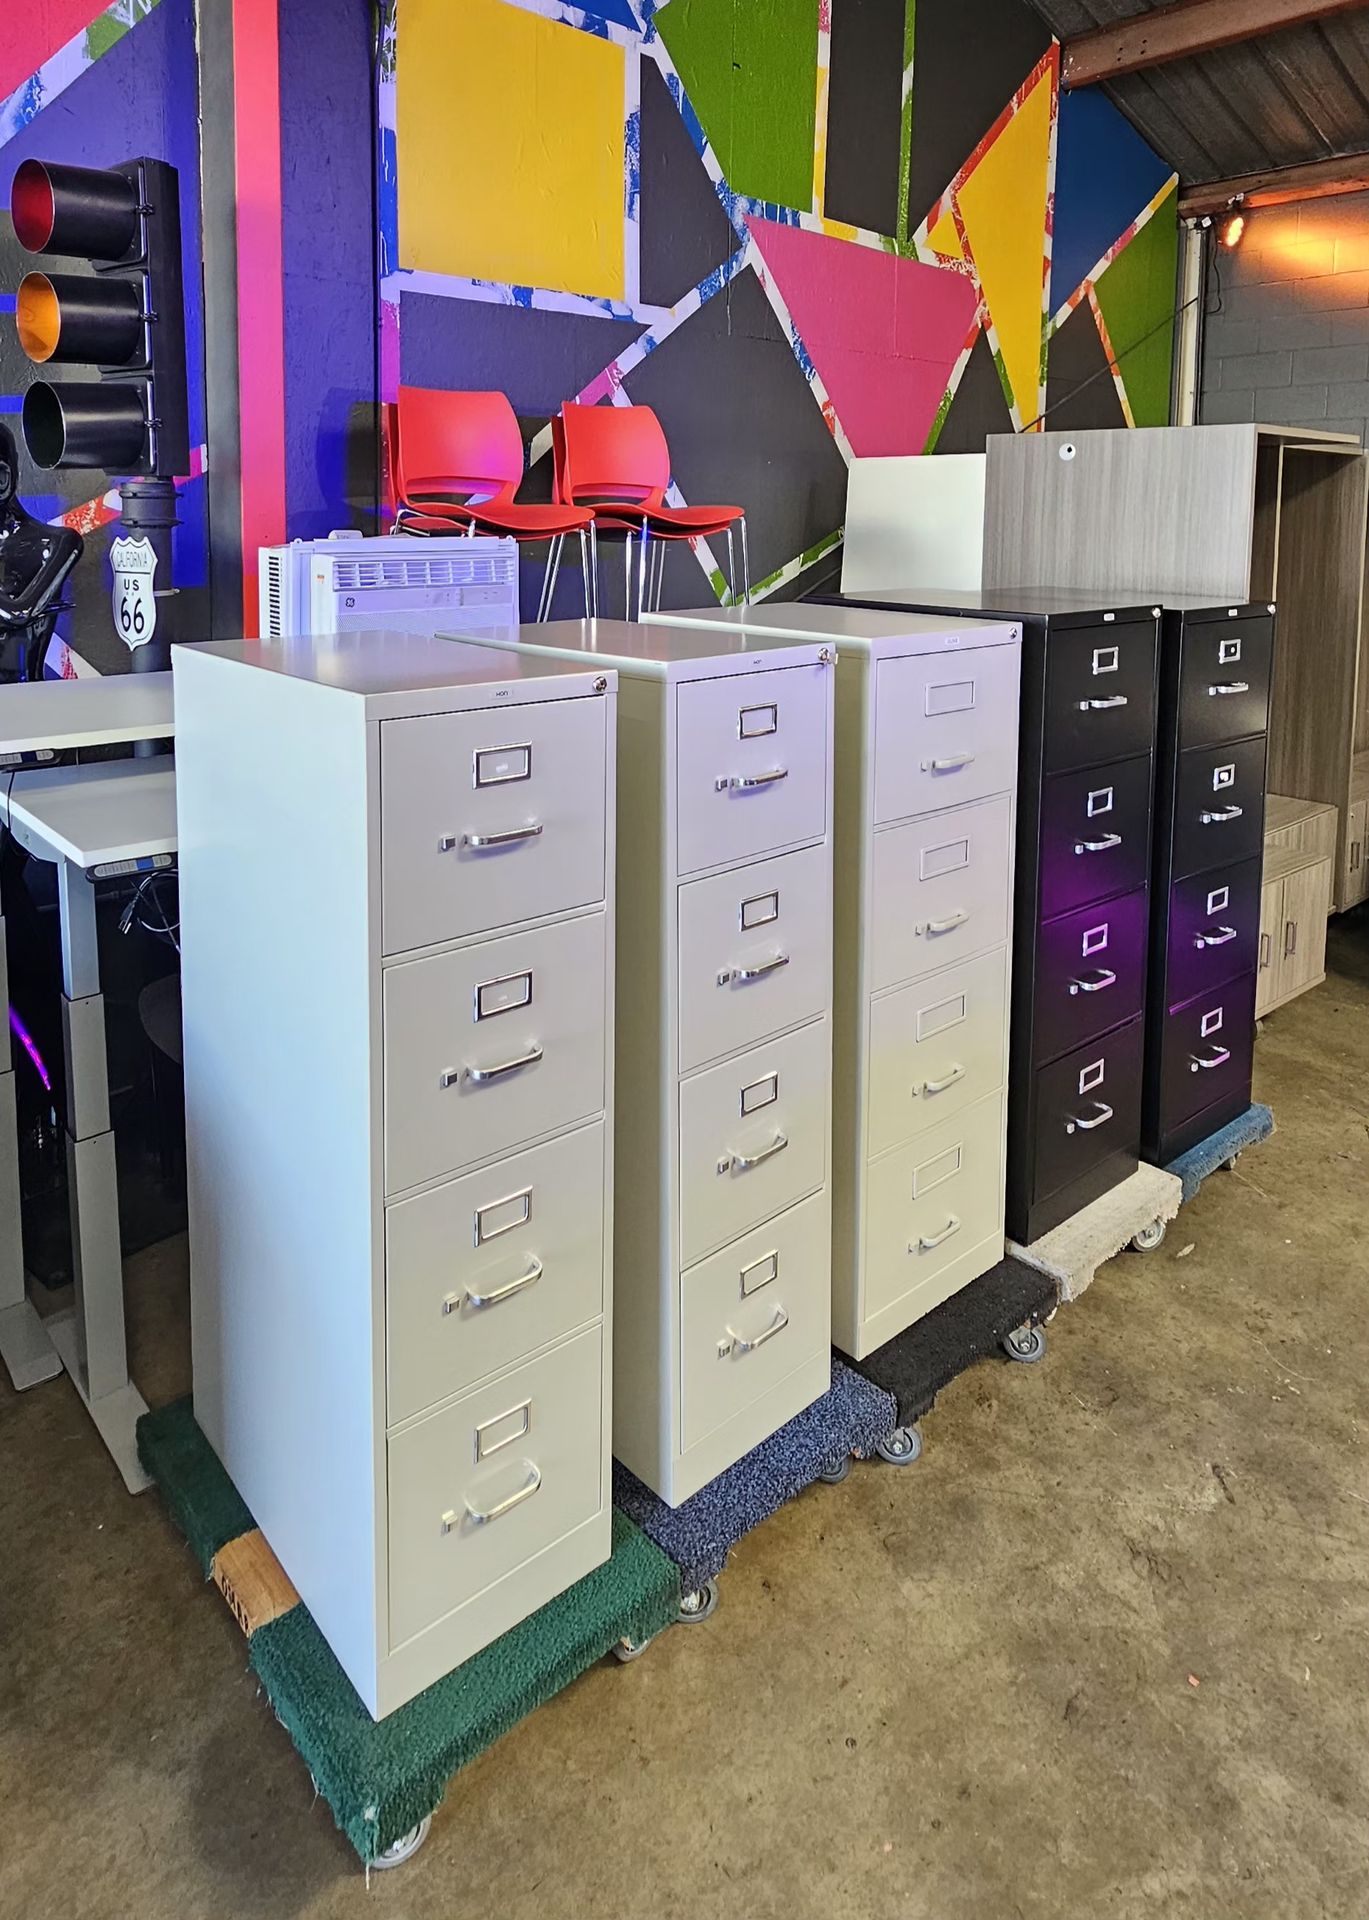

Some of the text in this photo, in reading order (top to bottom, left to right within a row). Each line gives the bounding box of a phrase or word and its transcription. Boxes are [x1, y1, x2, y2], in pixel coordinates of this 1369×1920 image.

[115, 551, 148, 568] CALIFORNIA
[123, 578, 140, 591] US
[120, 596, 145, 635] 66
